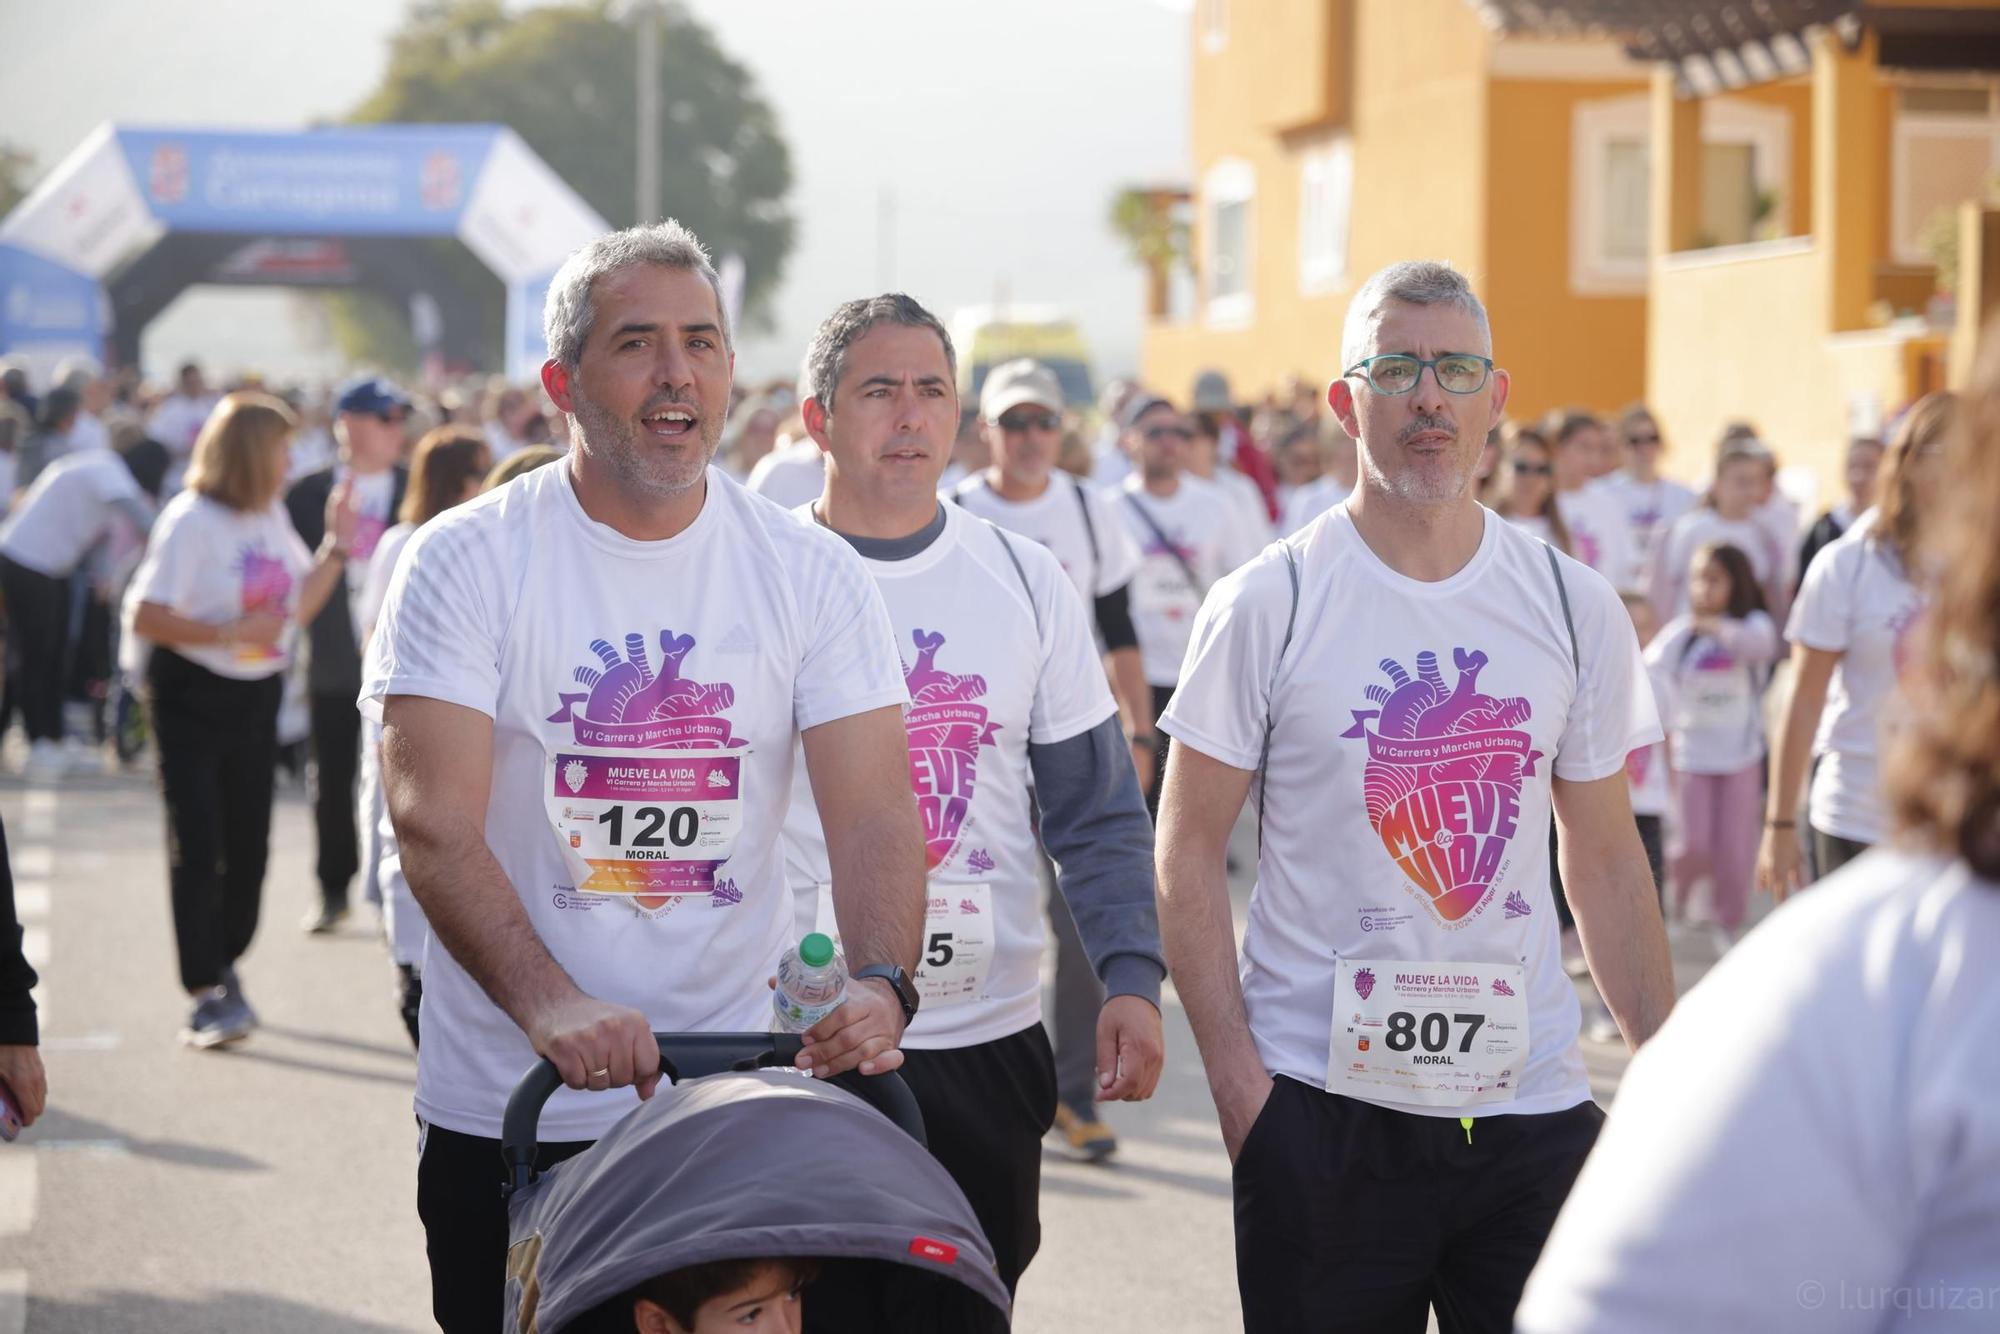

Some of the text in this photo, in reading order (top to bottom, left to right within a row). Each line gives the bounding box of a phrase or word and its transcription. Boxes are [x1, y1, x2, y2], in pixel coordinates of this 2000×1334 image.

[943, 709, 981, 720] Urbana
[582, 724, 723, 744] VI Carrera y Marcha Urbana
[1376, 737, 1524, 758] VI Carrera y Marcha Urbana
[608, 767, 696, 779] MUEVE LA VIDA
[672, 779, 696, 787] Urbana
[908, 749, 977, 800] EVE
[599, 805, 699, 847] 120
[918, 795, 968, 840] DA
[1381, 782, 1521, 860] MUEVE
[1436, 831, 1454, 845] la
[625, 850, 670, 860] MORAL
[1396, 834, 1507, 898] VIDA
[1481, 887, 1496, 907] Algar
[926, 932, 953, 967] 5
[1395, 973, 1479, 986] MUEVE LA VIDA
[1385, 1011, 1485, 1053] 807
[1413, 1055, 1454, 1065] MORAL
